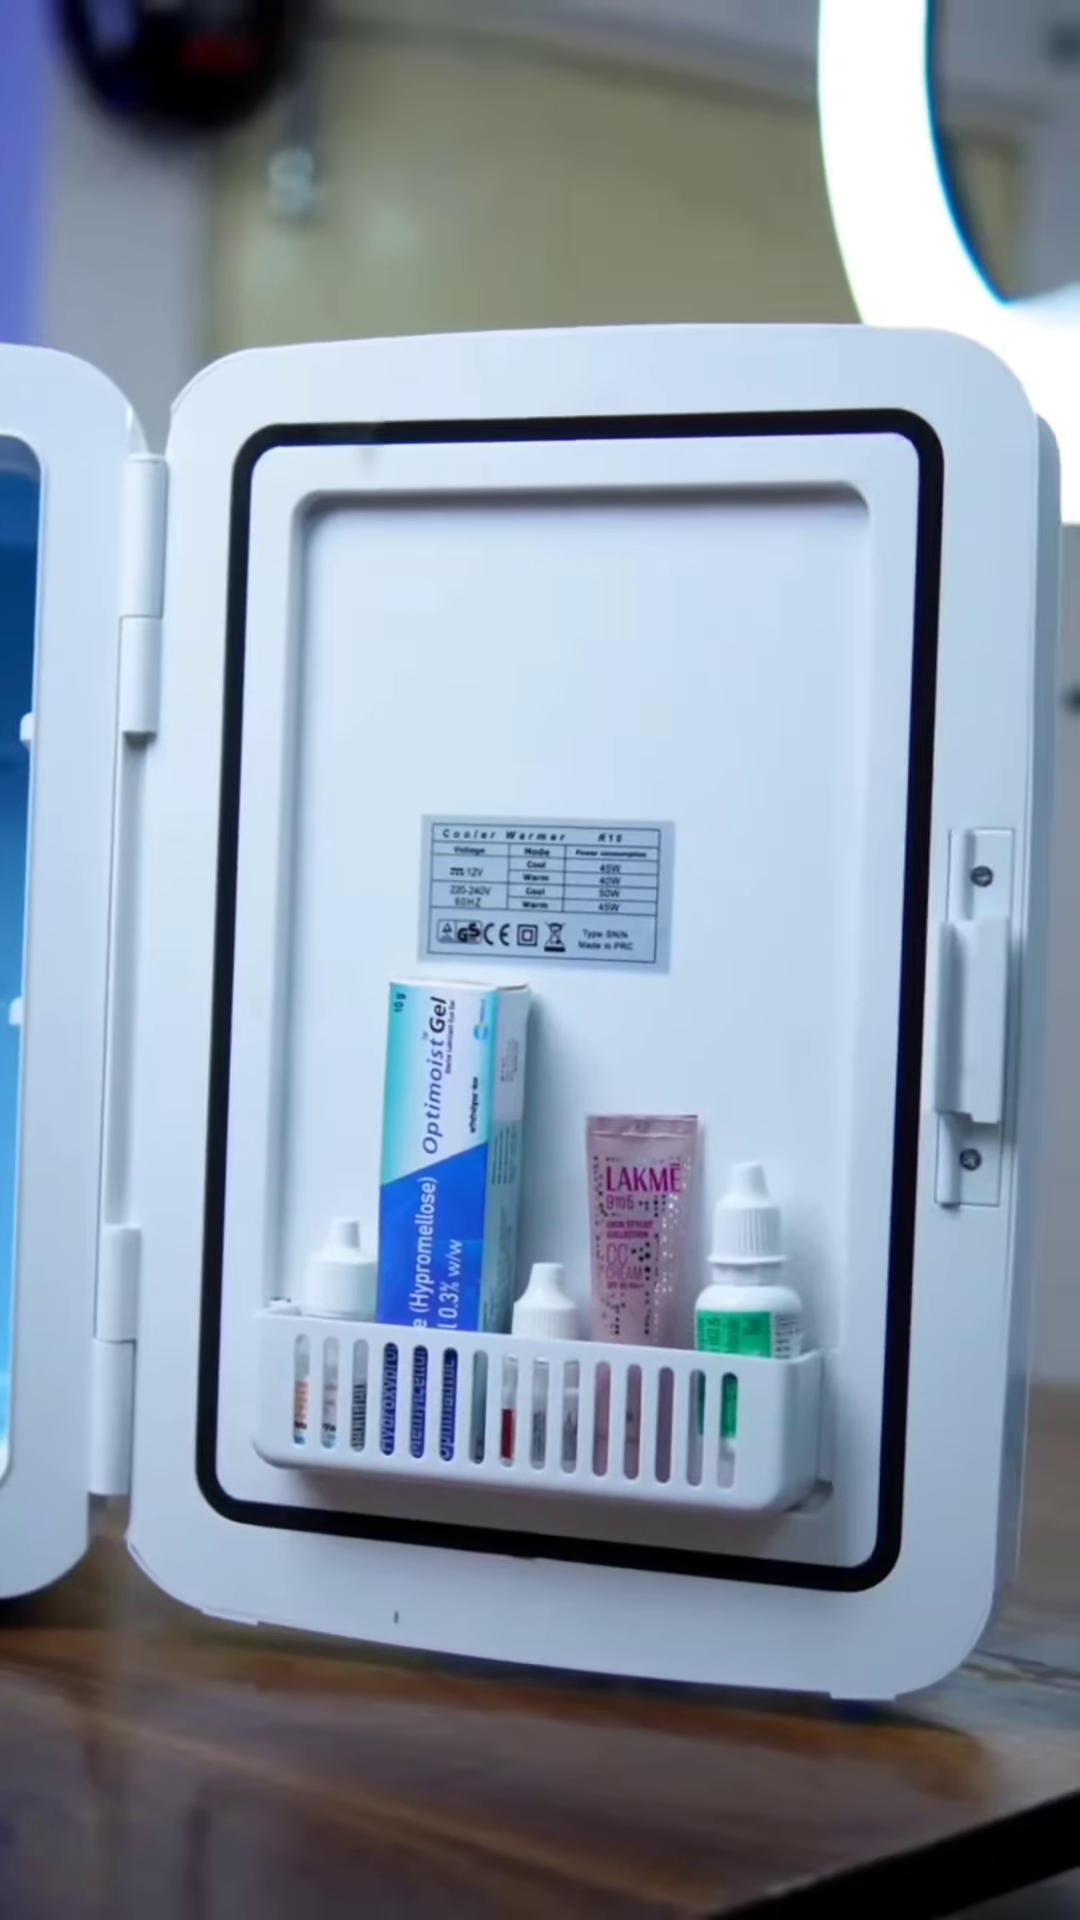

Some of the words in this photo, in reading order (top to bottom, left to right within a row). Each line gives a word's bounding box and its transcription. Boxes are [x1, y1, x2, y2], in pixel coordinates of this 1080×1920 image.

[442, 829, 496, 839] Cooler
[505, 830, 566, 841] Warmer
[524, 847, 550, 857] Mode
[526, 860, 546, 869] Cool
[466, 866, 484, 877] 12V
[522, 873, 550, 882] Warm
[525, 887, 545, 896] Cool
[522, 901, 549, 909] Warm
[483, 922, 511, 947] CE
[578, 941, 601, 950] Made
[429, 996, 448, 1034] Gel
[422, 1038, 445, 1155] Optimoist
[409, 1176, 439, 1314] (Hypromellose)
[445, 1239, 463, 1278] w/w
[437, 1281, 461, 1319] 0.3%
